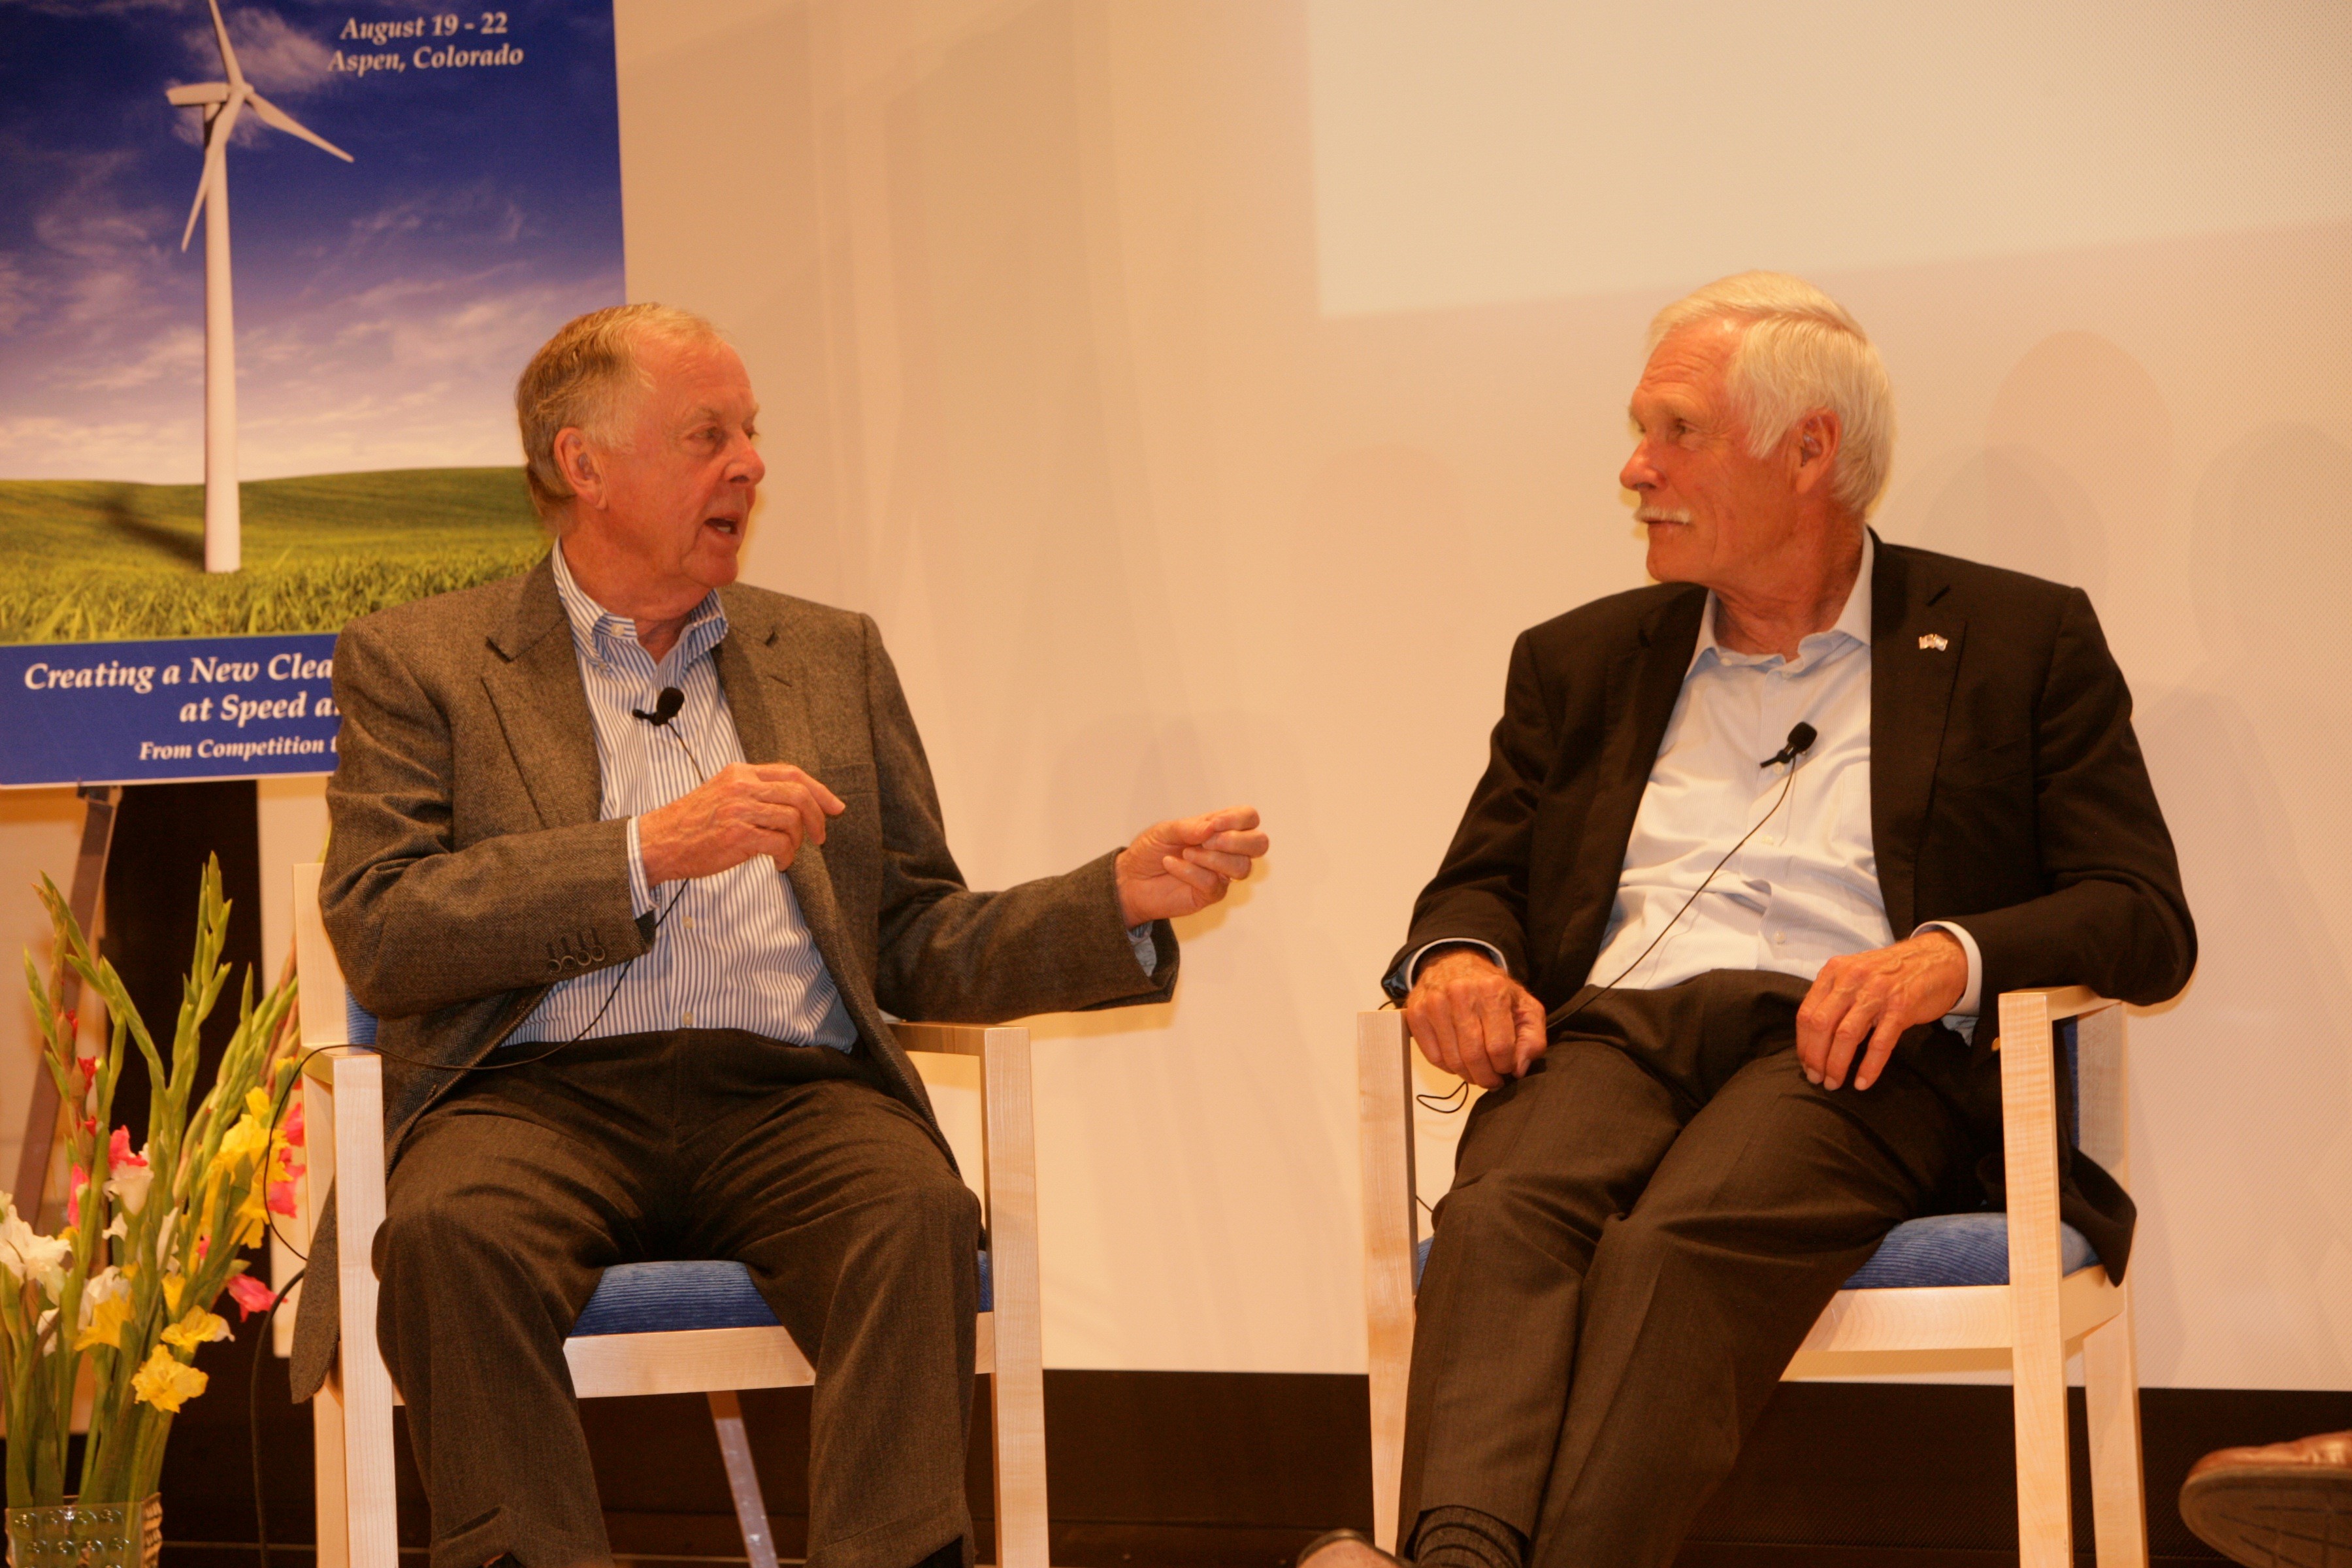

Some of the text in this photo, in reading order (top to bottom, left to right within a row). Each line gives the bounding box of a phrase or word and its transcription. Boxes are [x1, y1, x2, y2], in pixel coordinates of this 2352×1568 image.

[340, 17, 425, 45] August
[432, 14, 459, 36] 19
[481, 12, 508, 34] 22
[328, 43, 524, 77] Aspen, Colorado
[25, 661, 155, 694] Creating
[162, 665, 180, 685] a
[189, 657, 259, 683] New
[180, 698, 214, 723] at
[220, 691, 308, 728] Speed
[139, 742, 192, 760] From
[197, 735, 325, 761] Competition
